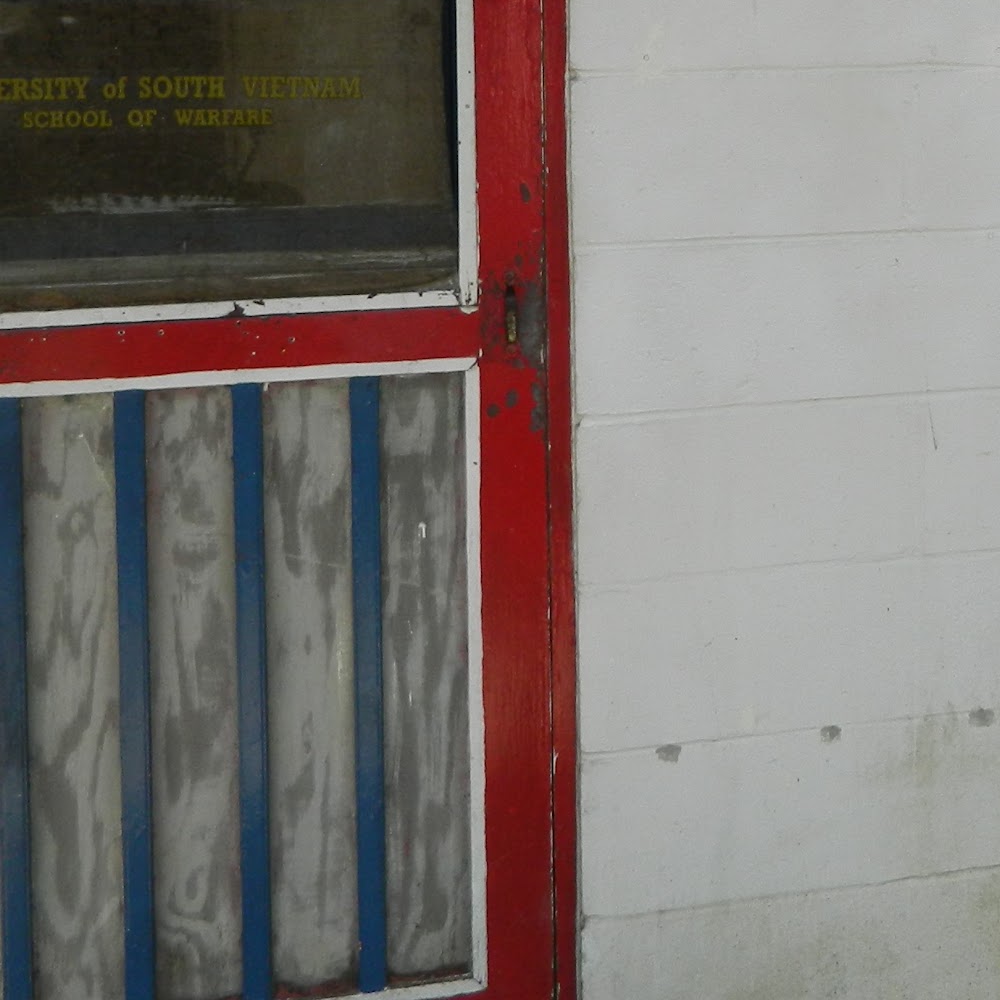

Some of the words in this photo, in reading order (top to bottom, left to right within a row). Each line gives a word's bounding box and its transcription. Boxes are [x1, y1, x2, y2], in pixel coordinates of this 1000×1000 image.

[0, 77, 90, 100] ERSITY
[103, 76, 129, 99] of
[138, 76, 226, 99] SOUTH
[242, 76, 363, 99] VIETNAM
[23, 110, 113, 128] SCHOOL
[128, 109, 157, 127] OF
[175, 109, 274, 126] WARFARE
